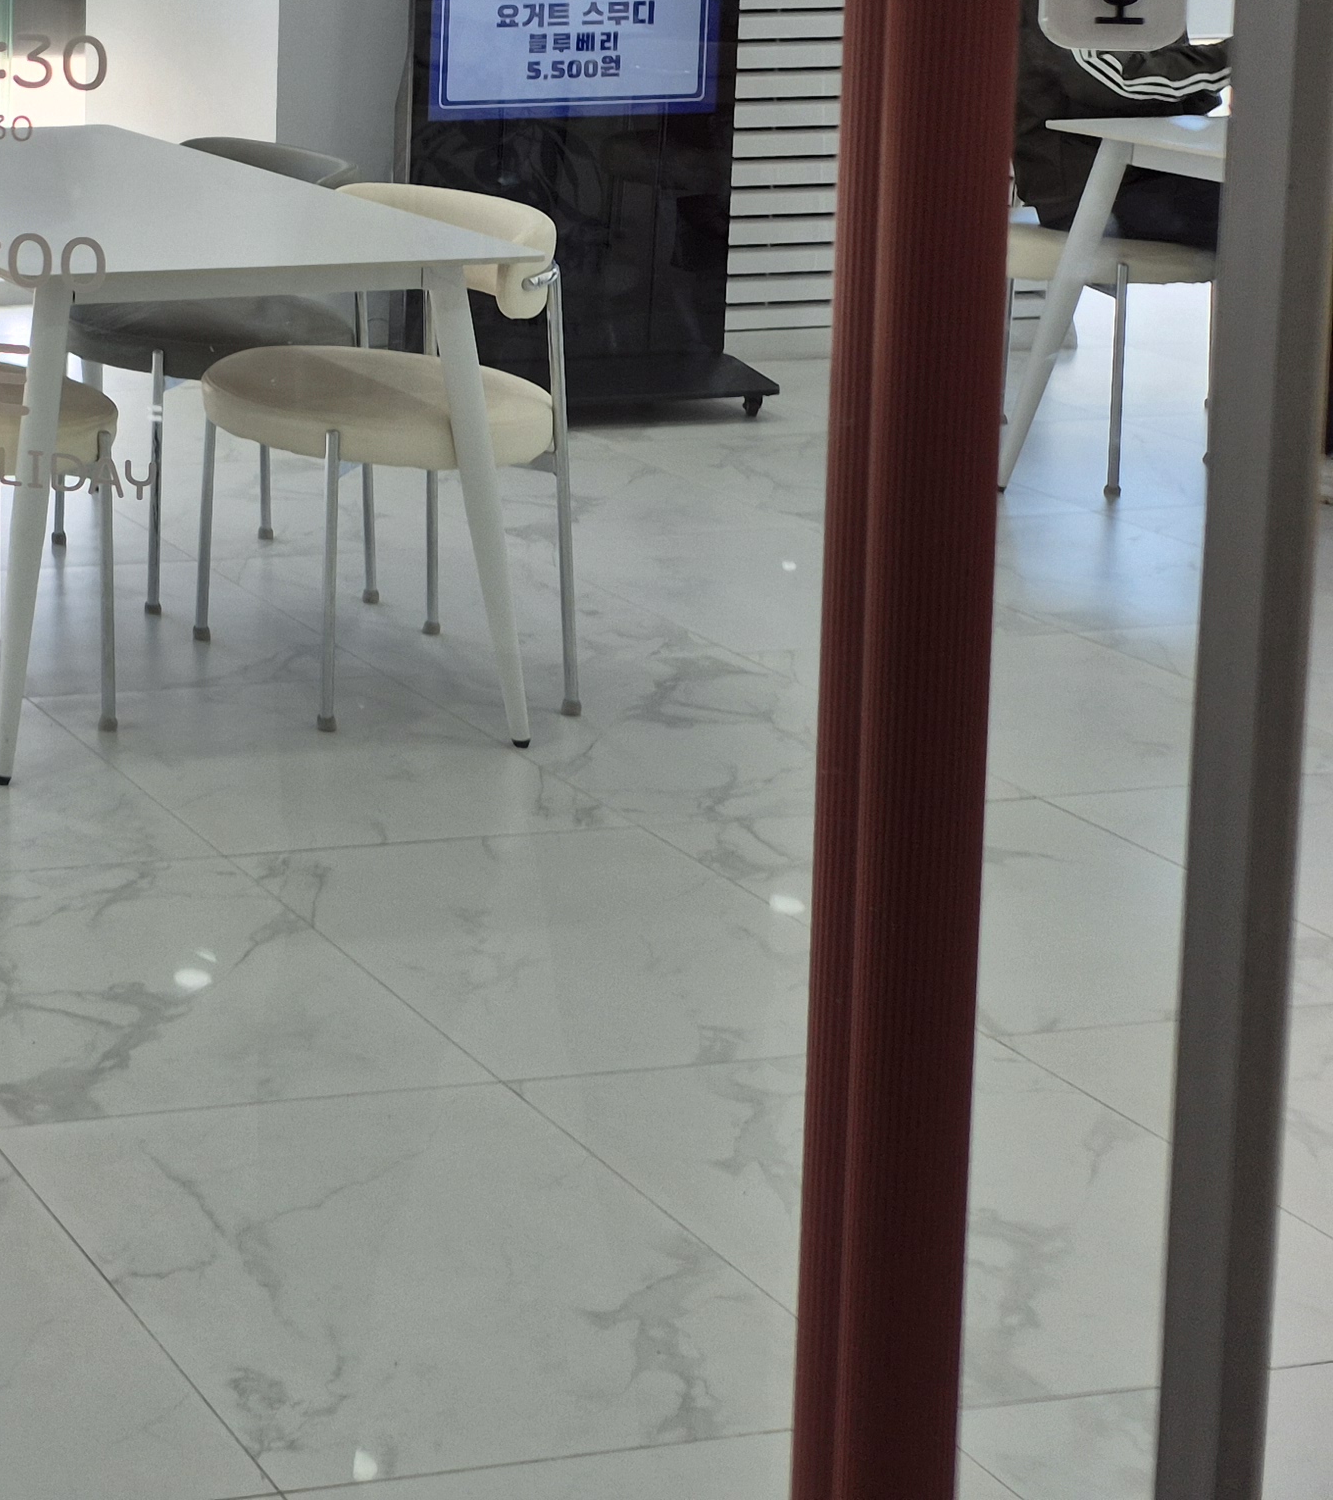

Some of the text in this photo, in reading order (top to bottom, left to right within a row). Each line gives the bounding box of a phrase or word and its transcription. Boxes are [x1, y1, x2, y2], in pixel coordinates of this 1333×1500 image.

[496, 0, 656, 29] 요거트 스무디
[528, 31, 620, 54] 블루베리
